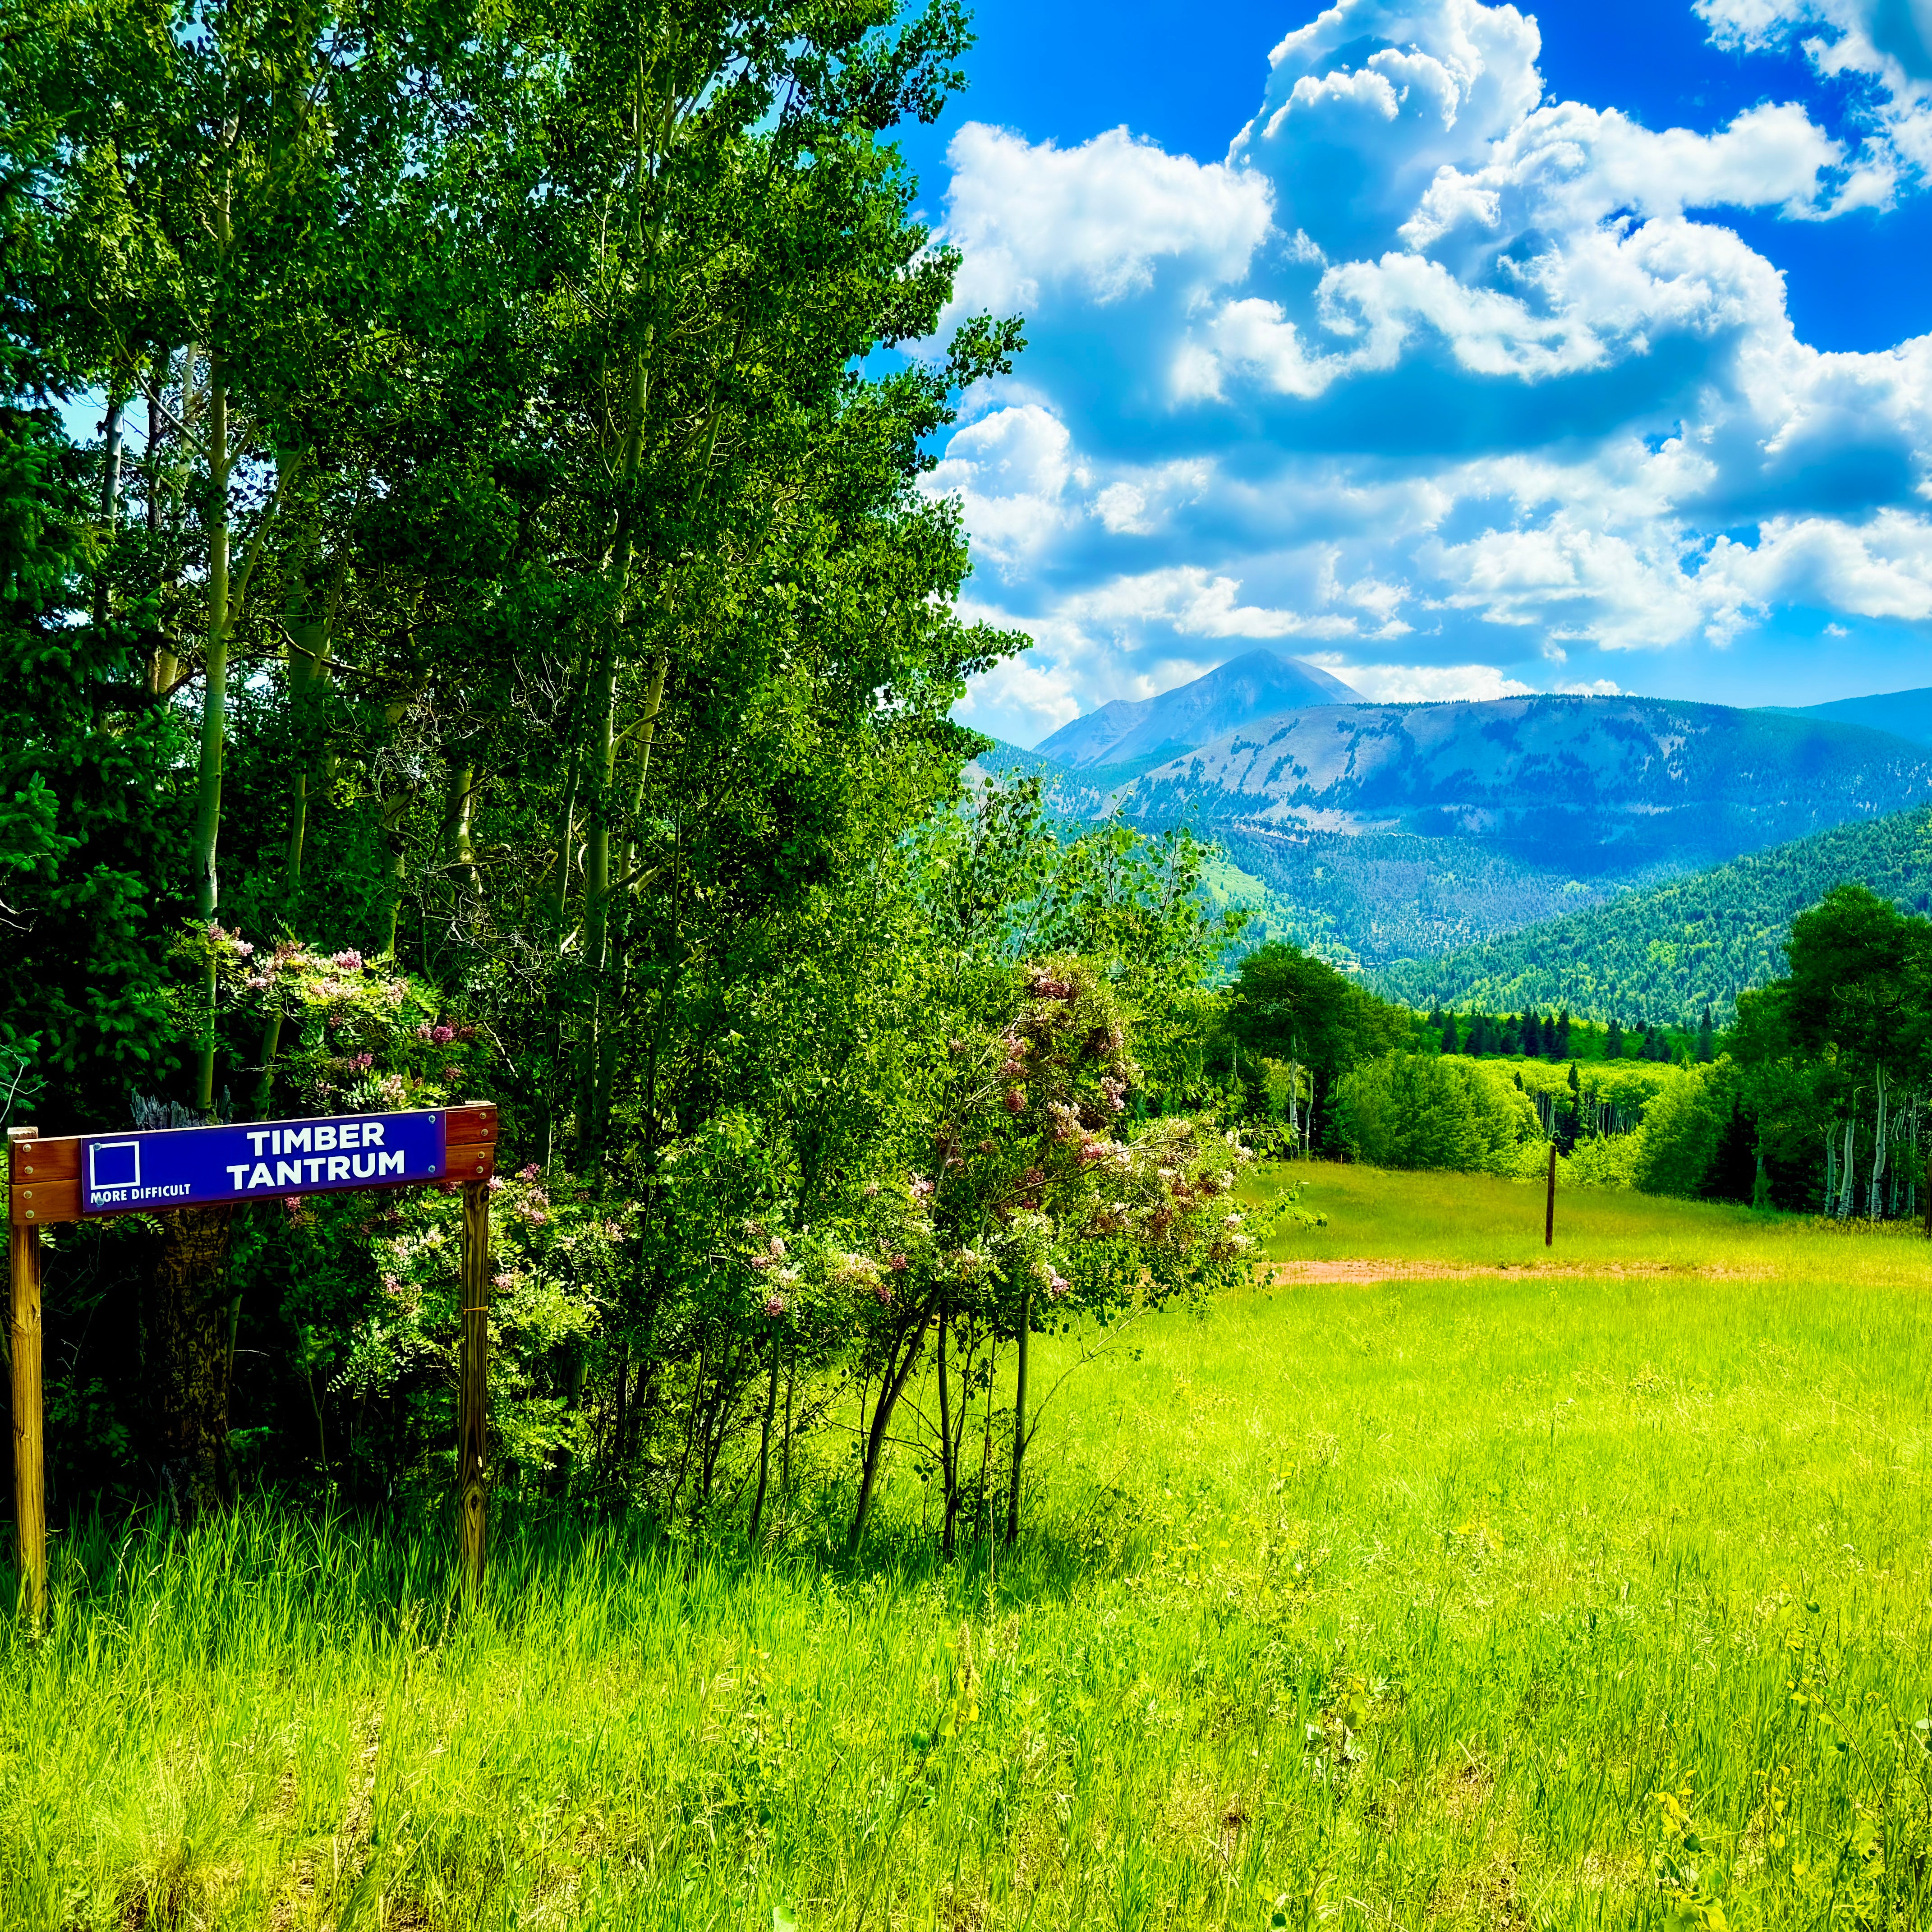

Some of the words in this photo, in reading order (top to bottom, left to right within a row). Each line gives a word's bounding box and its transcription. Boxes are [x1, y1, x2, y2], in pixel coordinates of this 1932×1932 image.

[247, 1122, 385, 1156] TIMBER
[226, 1150, 405, 1190] TANTRUM
[90, 1189, 127, 1204] MORE
[131, 1183, 191, 1200] DIFFICULT
